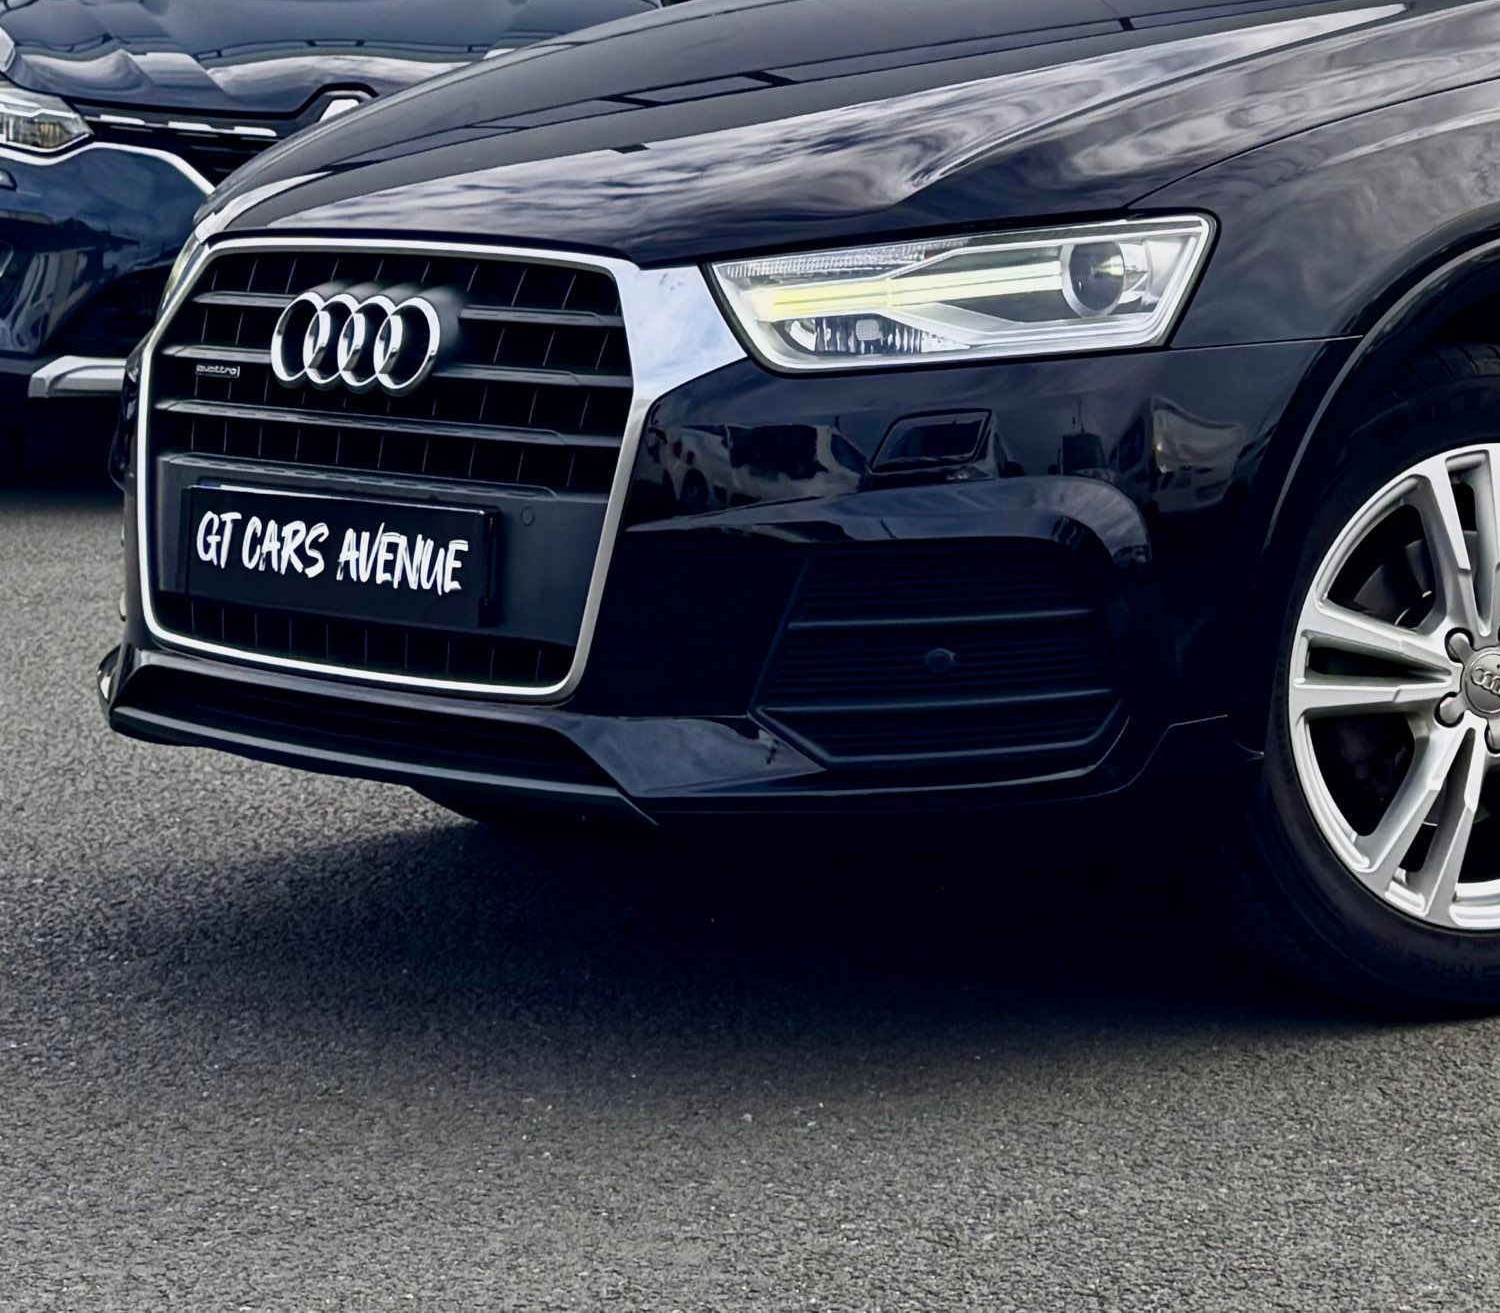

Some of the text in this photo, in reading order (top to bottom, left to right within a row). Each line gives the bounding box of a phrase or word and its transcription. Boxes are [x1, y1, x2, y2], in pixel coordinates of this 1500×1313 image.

[196, 510, 470, 596] GT CARS AVENUE
